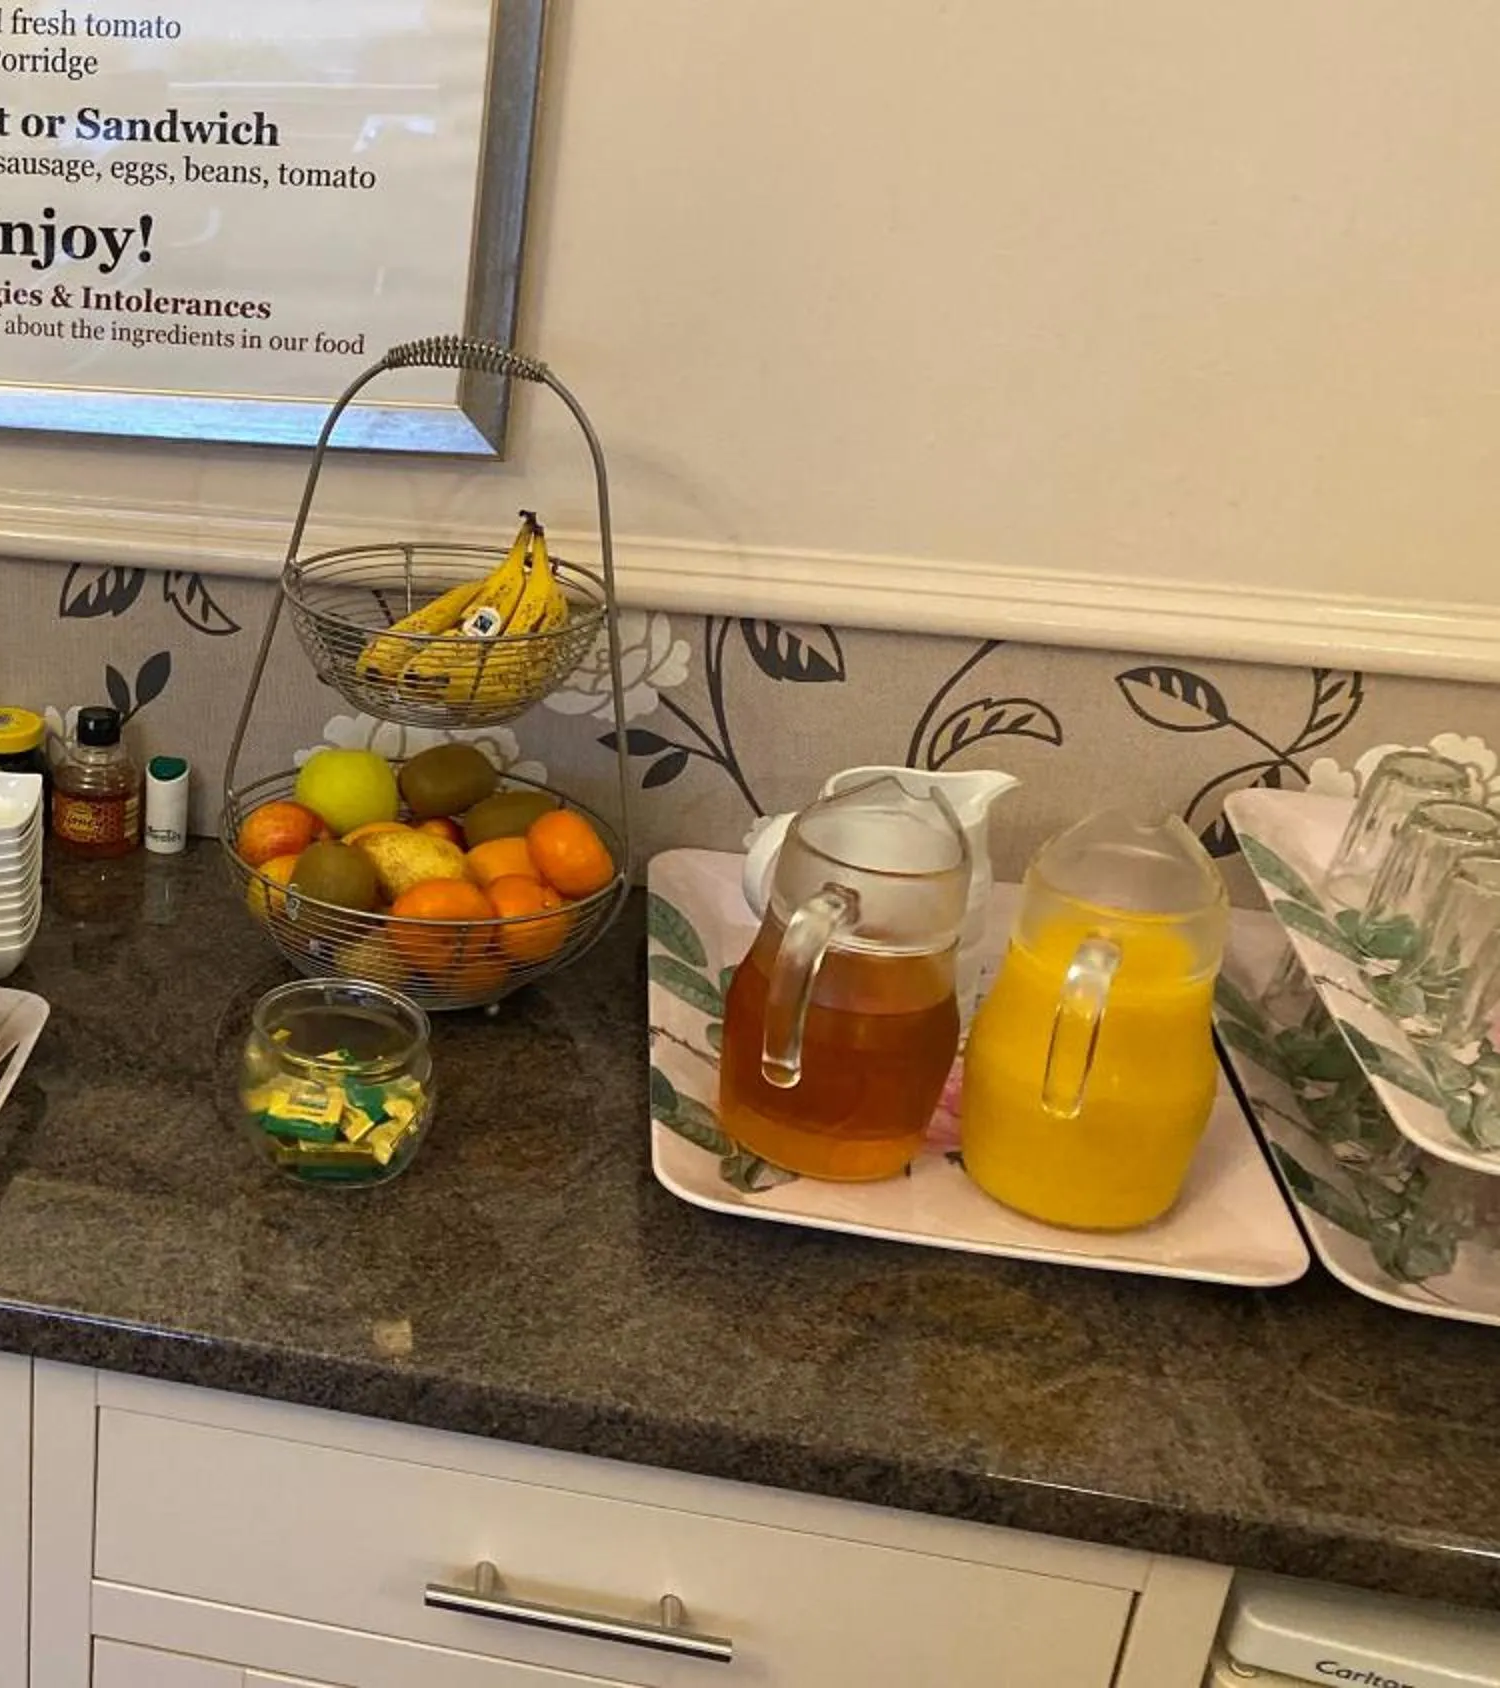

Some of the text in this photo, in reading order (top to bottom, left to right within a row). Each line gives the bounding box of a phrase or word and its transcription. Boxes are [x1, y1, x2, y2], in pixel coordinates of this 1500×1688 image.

[11, 9, 76, 37] fresh
[85, 14, 182, 40] tomato
[21, 112, 66, 140] or
[75, 107, 280, 147] Sandwich
[110, 162, 176, 188] eggs,
[184, 157, 269, 189] beans,
[278, 162, 377, 190] tomato
[50, 285, 73, 309] &
[82, 286, 272, 320] Intolerances
[4, 317, 65, 339] about
[70, 320, 105, 341] the
[111, 324, 236, 349] ingredients
[240, 331, 263, 350] in
[268, 335, 310, 352] our
[314, 333, 365, 355] food
